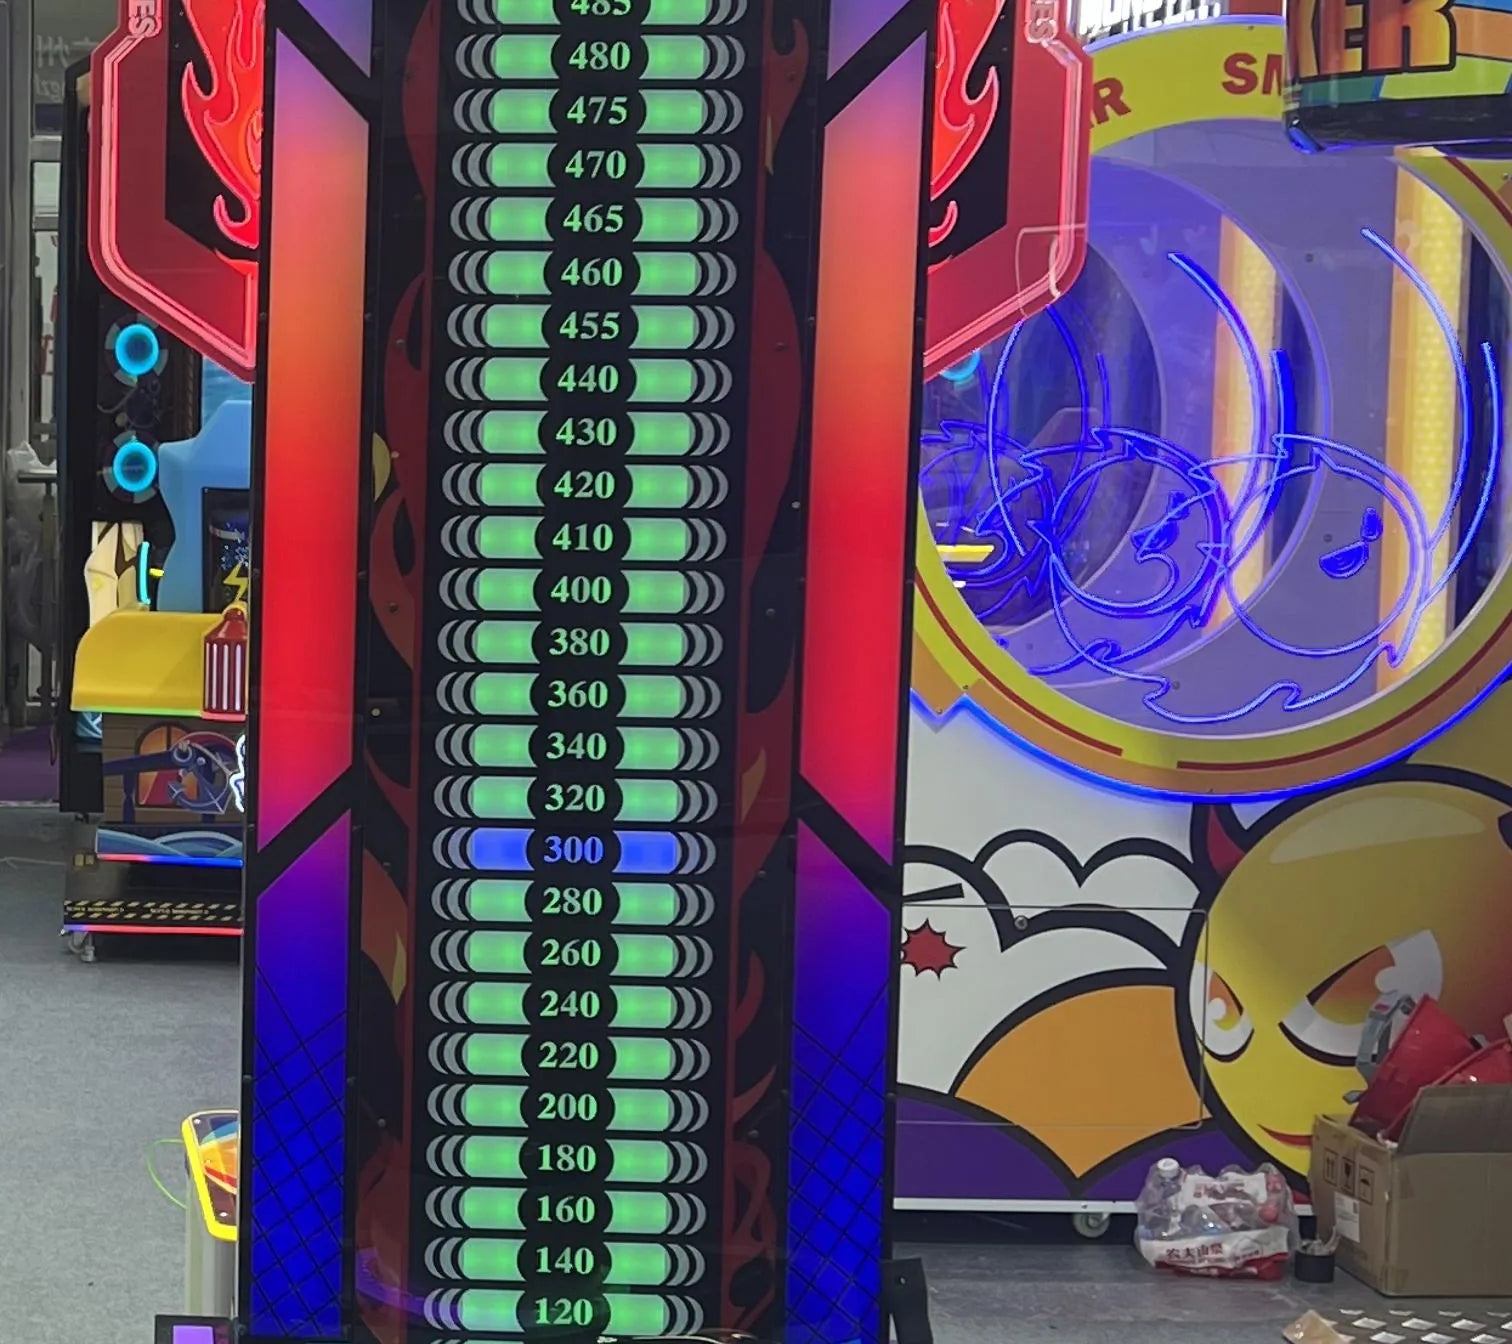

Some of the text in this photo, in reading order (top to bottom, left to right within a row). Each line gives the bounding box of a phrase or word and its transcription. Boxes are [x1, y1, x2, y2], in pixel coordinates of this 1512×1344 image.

[568, 41, 631, 70] 480
[566, 96, 628, 125] 475
[565, 150, 627, 179] 470
[563, 204, 623, 233] 465
[560, 258, 623, 287] 460
[559, 311, 620, 340] 455
[557, 364, 619, 393] 440
[555, 417, 617, 446] 430
[553, 470, 615, 499] 420
[552, 523, 613, 552] 410
[550, 575, 612, 604] 400
[549, 628, 610, 656] 380
[547, 680, 608, 708] 360
[546, 732, 607, 760] 340
[544, 784, 605, 812] 320
[543, 835, 604, 864] 300
[542, 887, 602, 915] 280
[541, 938, 601, 967] 260
[539, 990, 600, 1018] 240
[538, 1041, 599, 1070] 220
[537, 1092, 598, 1121] 200
[537, 1144, 596, 1172] 180
[536, 1195, 595, 1224] 160
[534, 1246, 595, 1275] 140
[534, 1297, 594, 1326] 120
